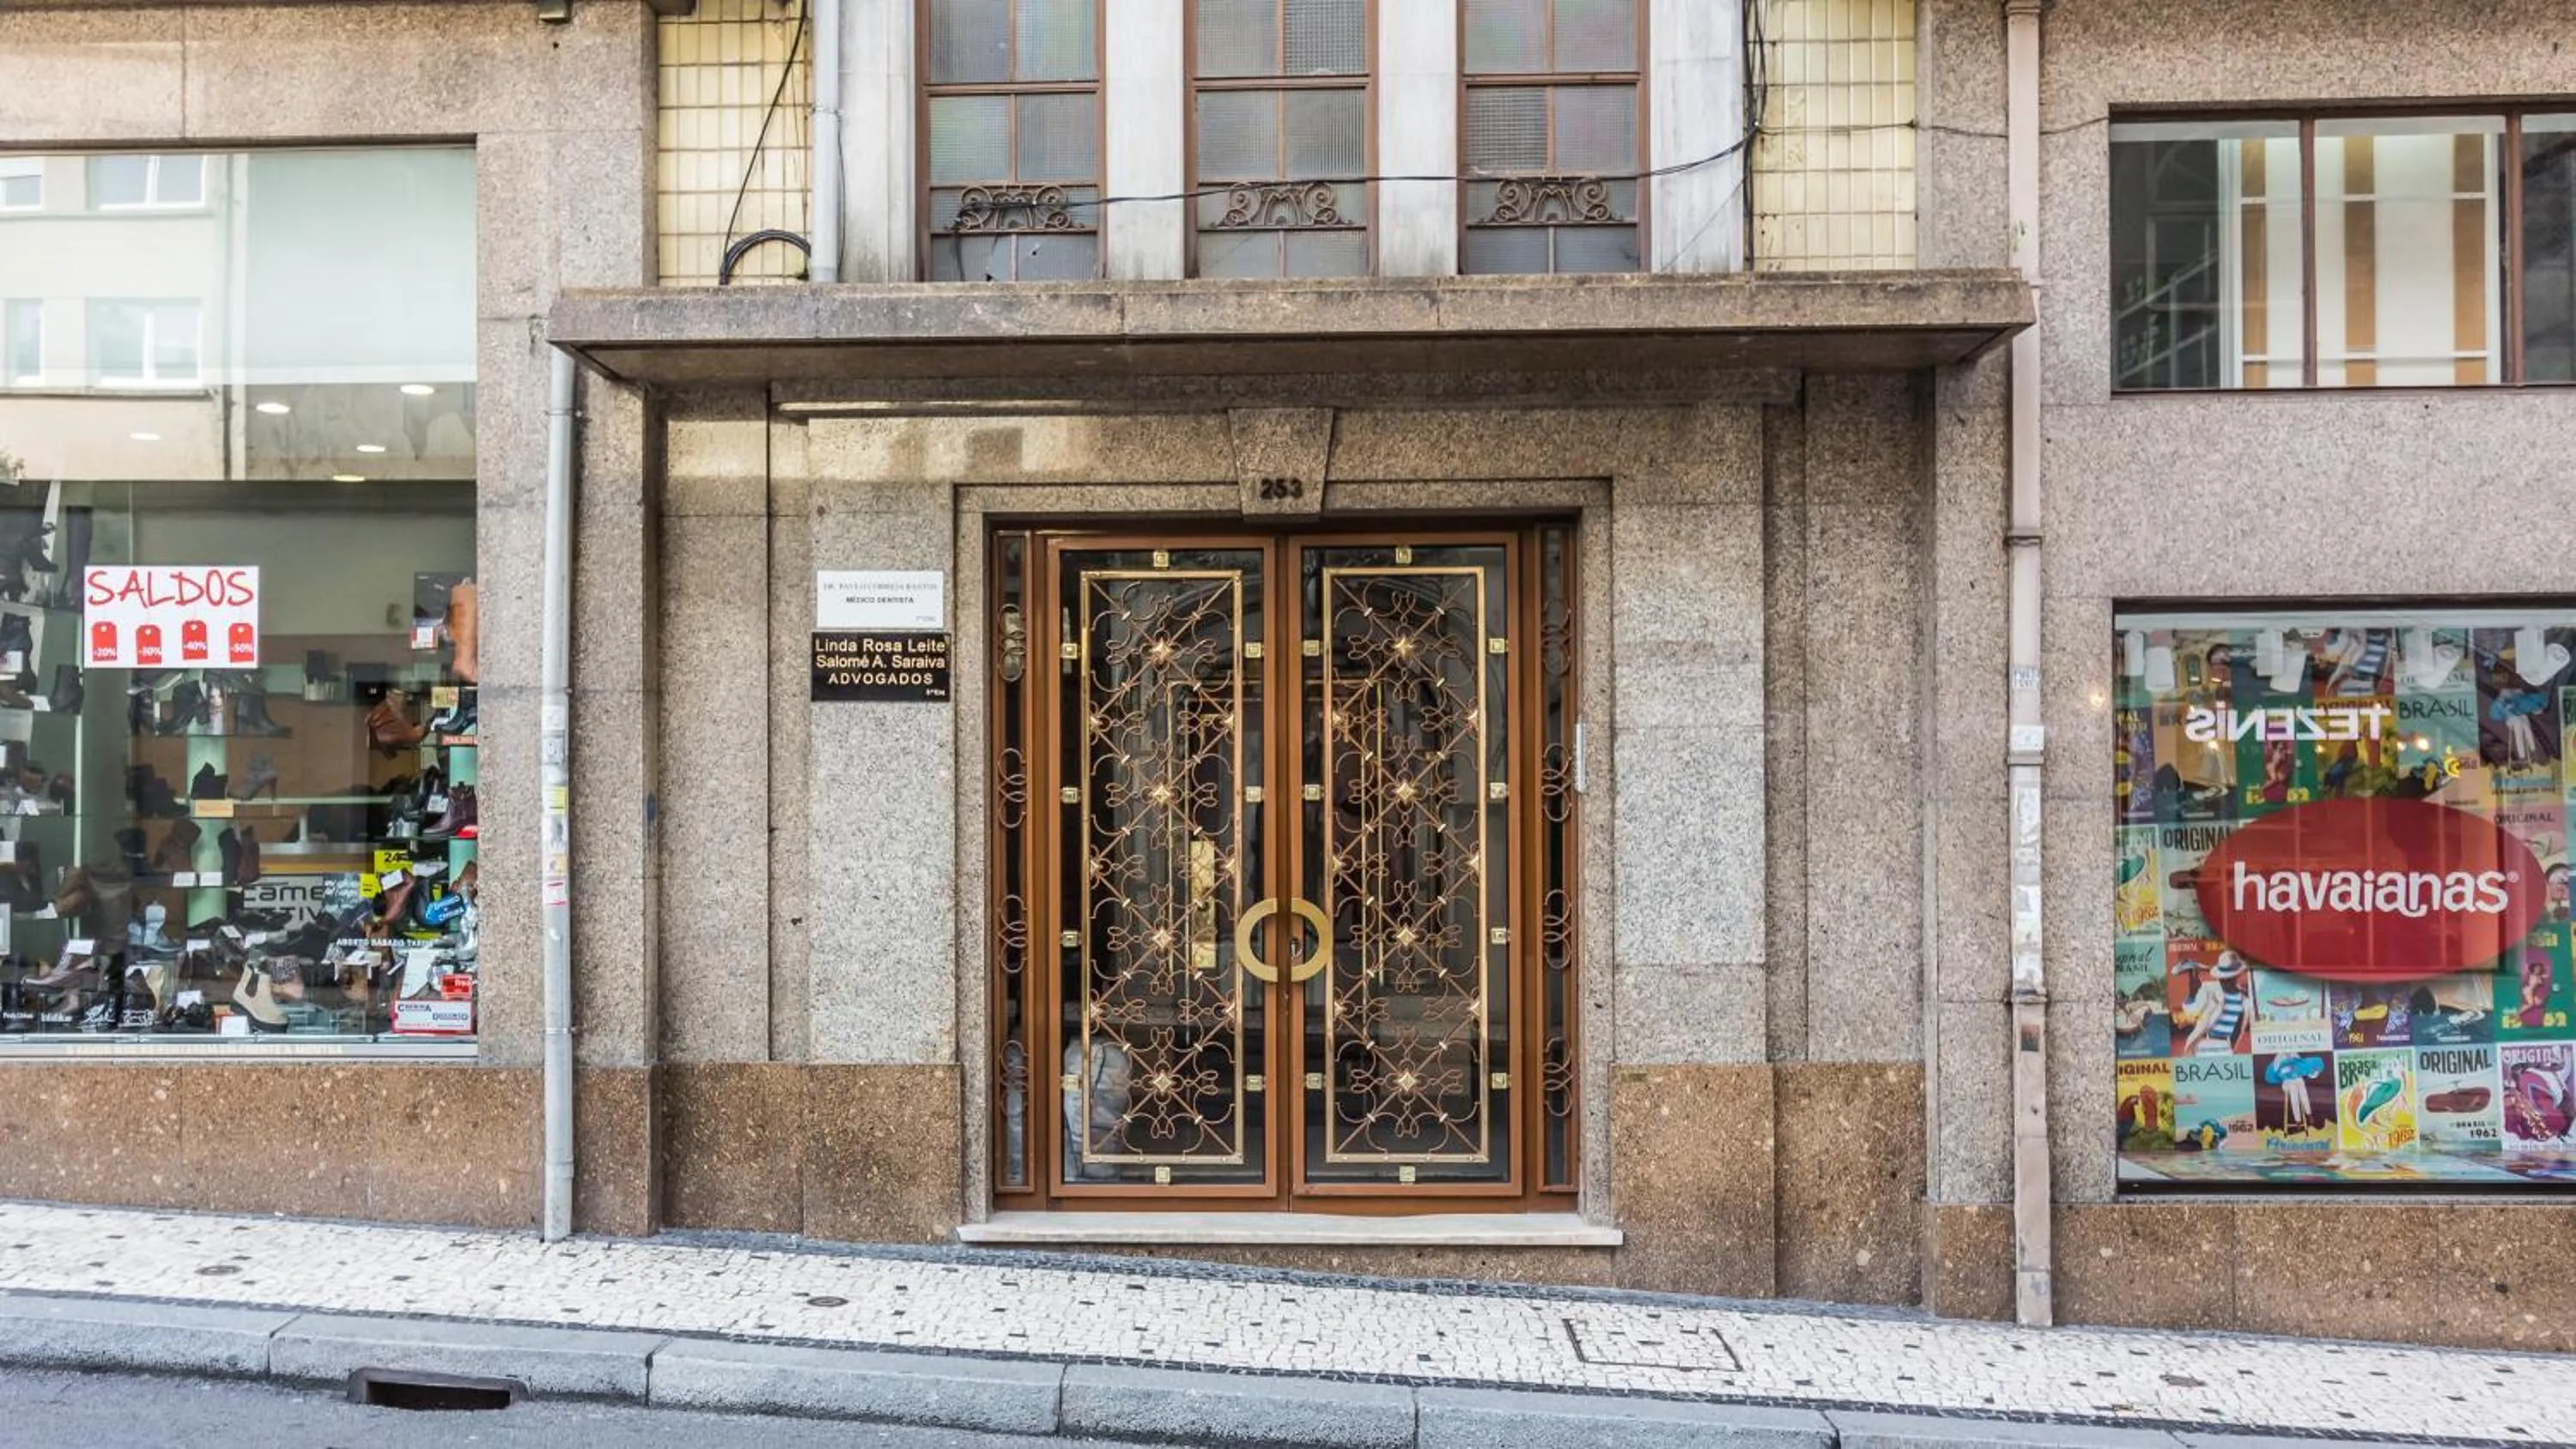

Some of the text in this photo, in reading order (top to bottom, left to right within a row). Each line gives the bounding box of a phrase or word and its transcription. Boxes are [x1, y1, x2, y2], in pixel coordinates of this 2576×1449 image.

[1260, 478, 1303, 499] 253
[88, 570, 253, 608] SALDOS
[816, 638, 945, 652] Linda Rosa Leite
[817, 654, 945, 668] Salomé A. Saraiva
[828, 672, 933, 684] ADVOGADOS
[2398, 698, 2474, 719] BRASIL
[2233, 861, 2509, 917] havaianas
[2420, 1049, 2493, 1073] ORIGINAL
[2175, 1062, 2252, 1082] BRASIL
